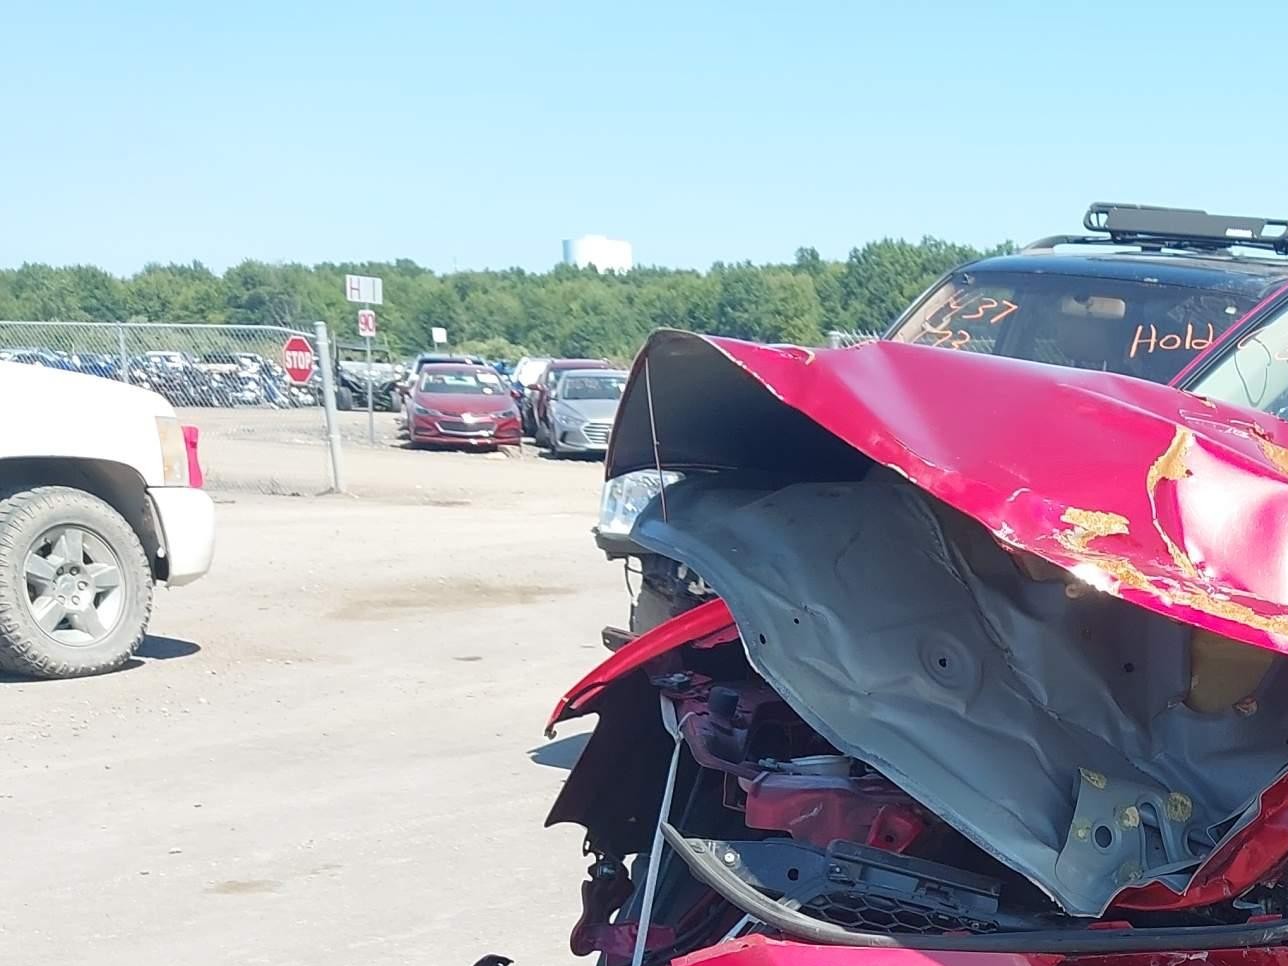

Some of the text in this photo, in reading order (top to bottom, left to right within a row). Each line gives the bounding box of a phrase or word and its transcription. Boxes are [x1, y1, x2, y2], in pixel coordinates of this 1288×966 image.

[350, 277, 361, 300] H
[360, 313, 376, 333] 90
[1129, 322, 1215, 358] Hold
[285, 350, 313, 370] STOP
